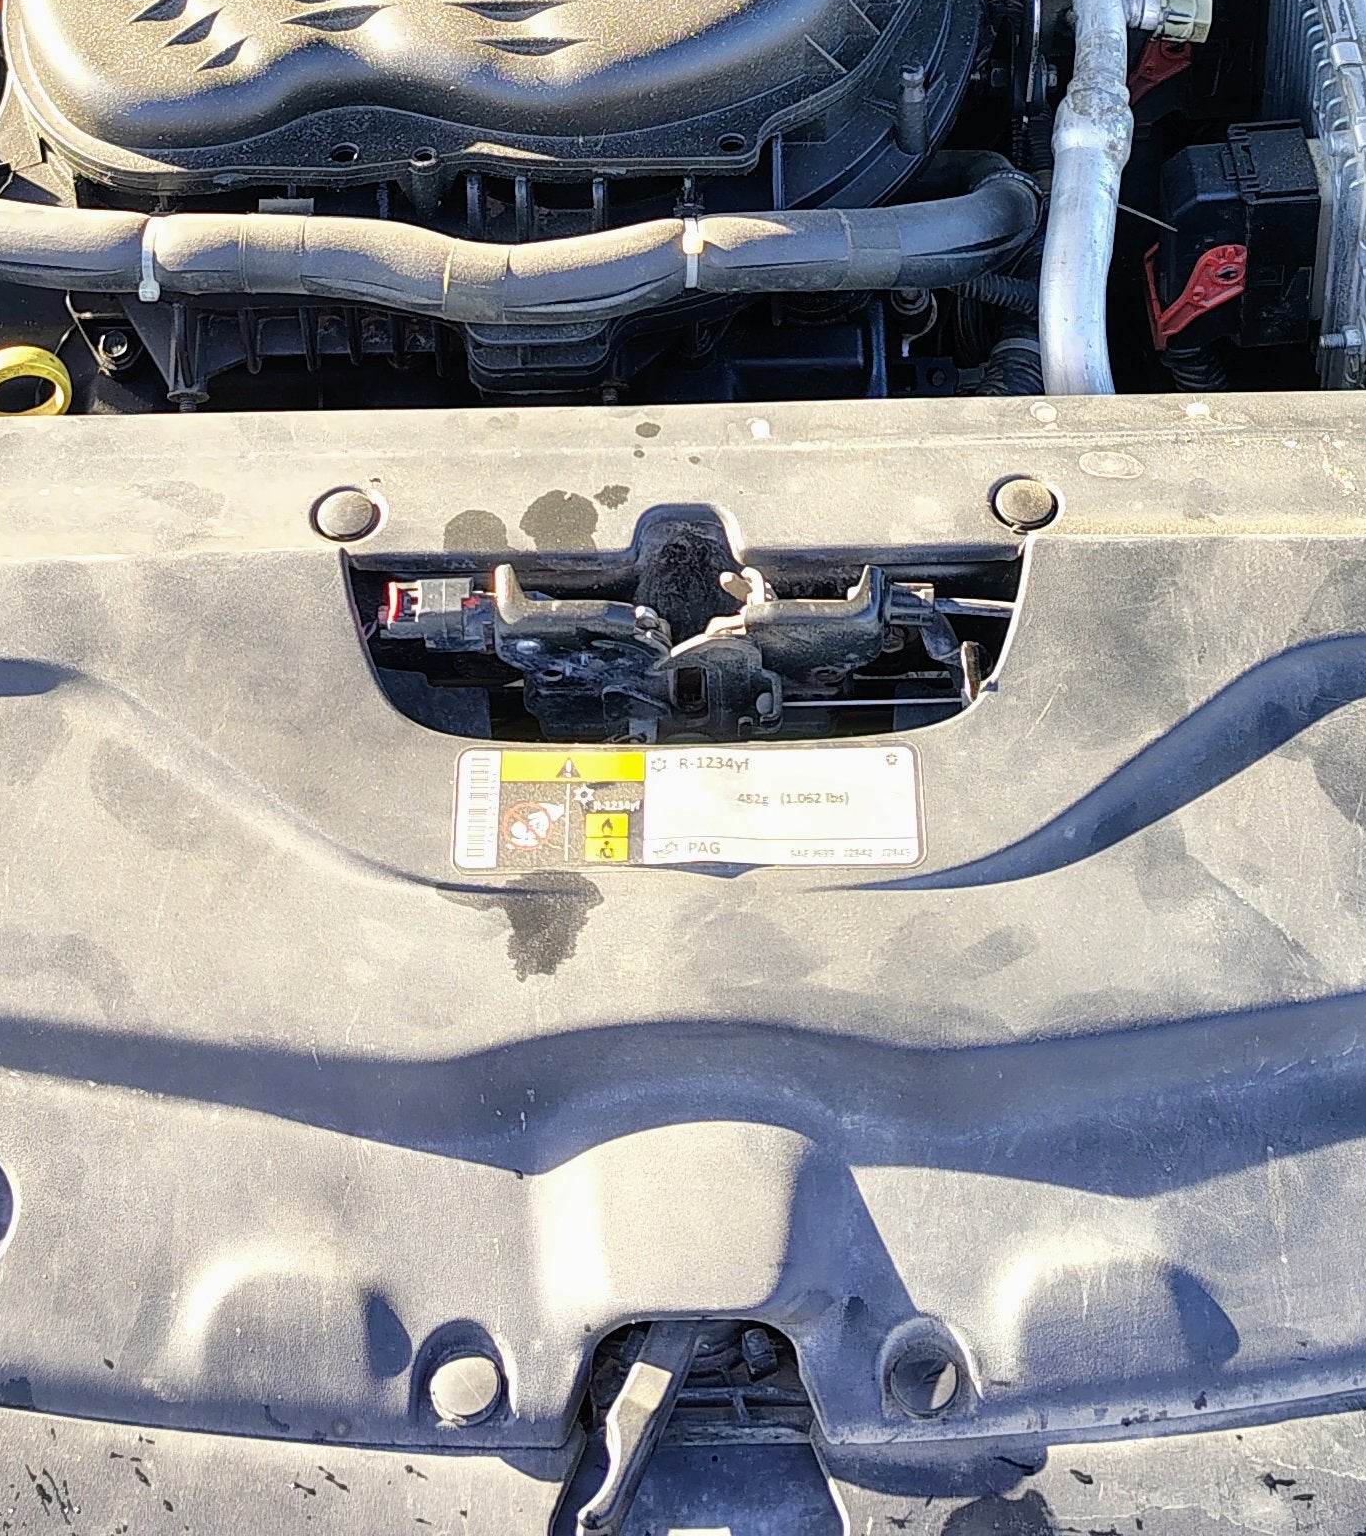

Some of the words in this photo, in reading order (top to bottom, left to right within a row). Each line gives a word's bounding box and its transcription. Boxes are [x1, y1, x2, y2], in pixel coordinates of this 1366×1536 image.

[678, 757, 750, 774] R-1234yf
[825, 791, 850, 806] lbs)
[688, 841, 721, 856] PAG
